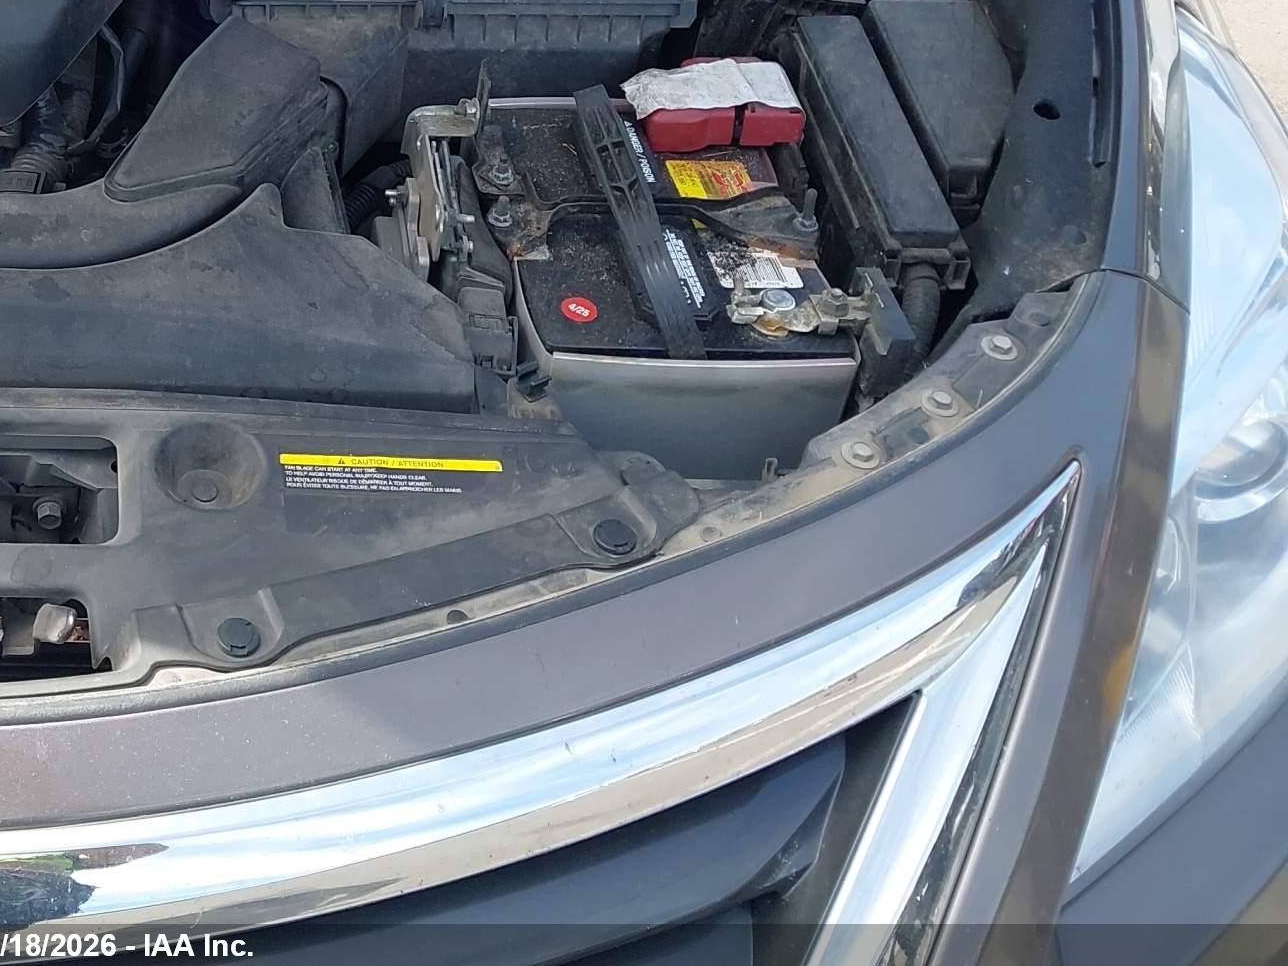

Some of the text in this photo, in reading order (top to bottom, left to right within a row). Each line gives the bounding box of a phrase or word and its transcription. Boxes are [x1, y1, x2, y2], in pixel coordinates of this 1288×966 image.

[568, 303, 590, 317] 4/25
[351, 458, 388, 466] CAUTION
[398, 460, 444, 468] ATTENTION
